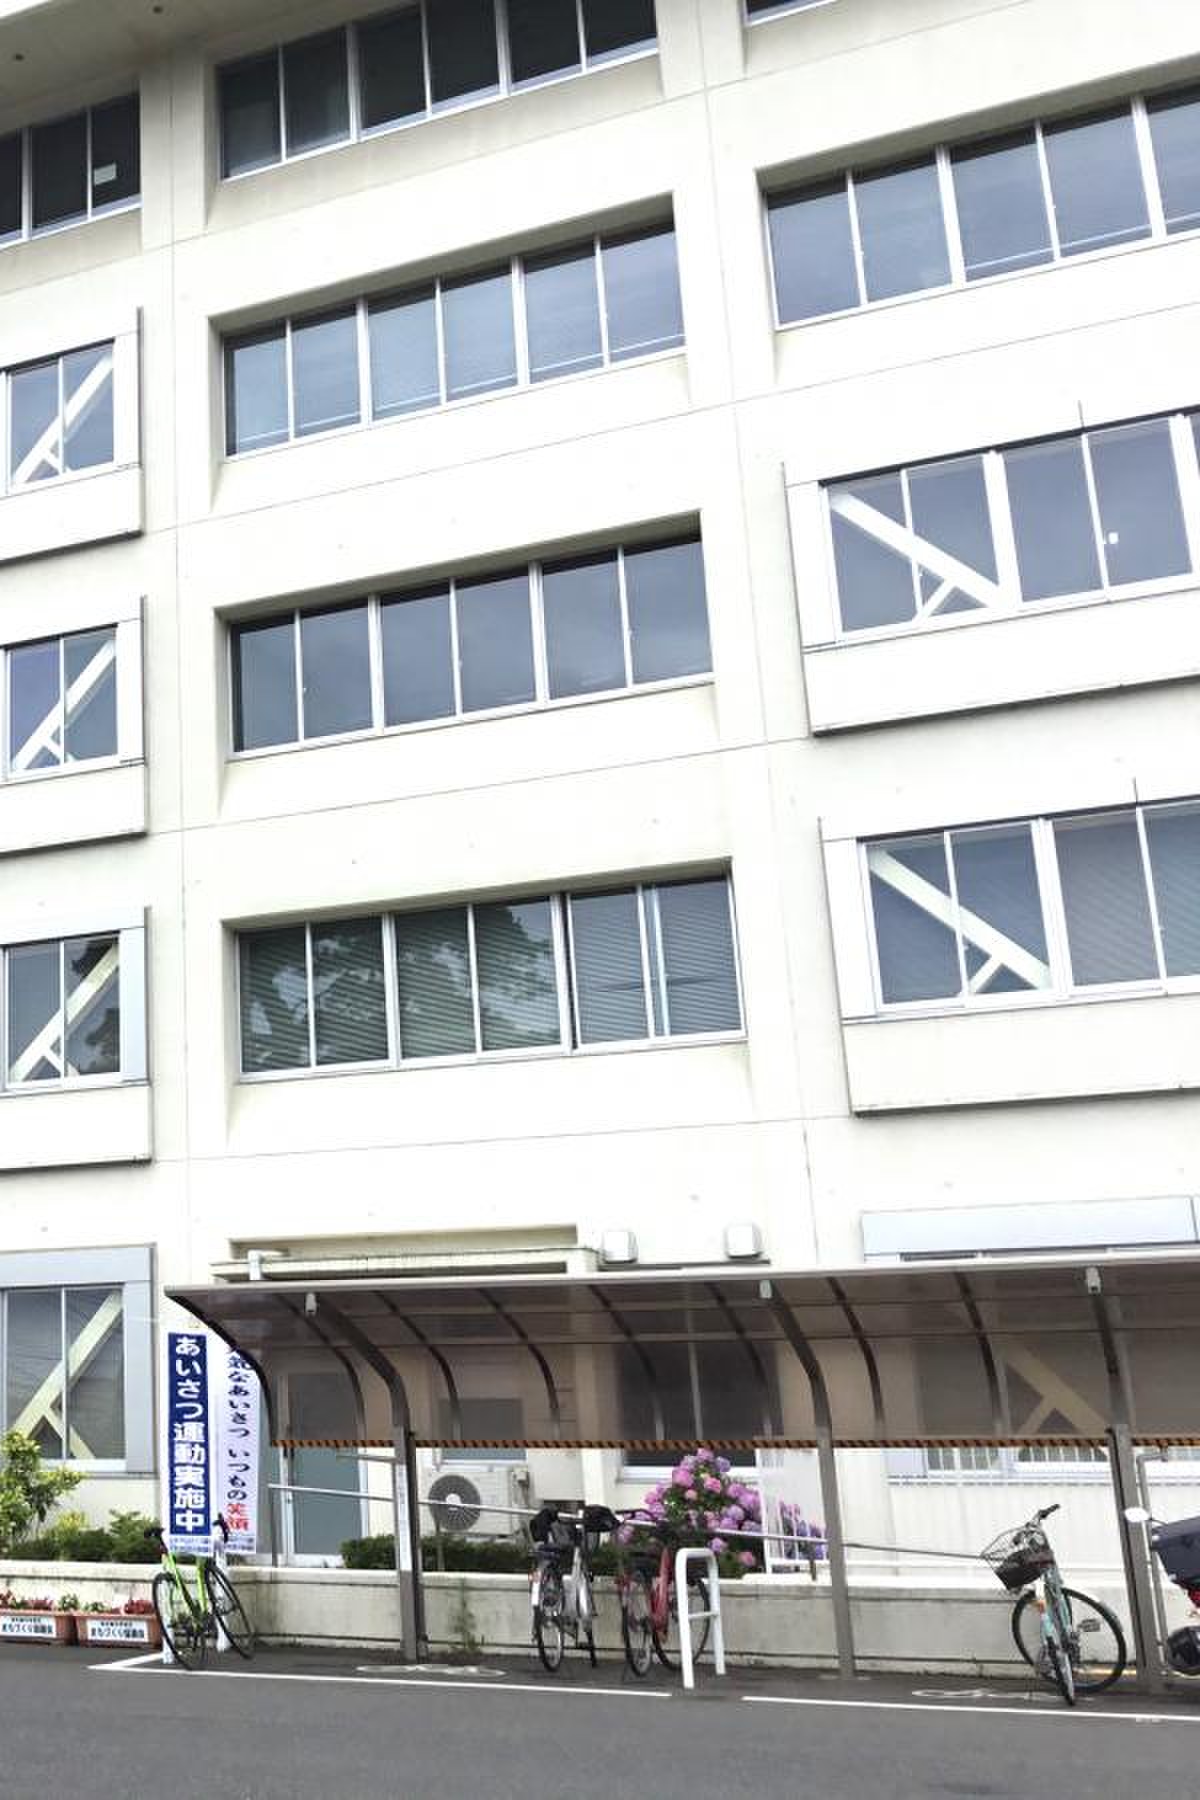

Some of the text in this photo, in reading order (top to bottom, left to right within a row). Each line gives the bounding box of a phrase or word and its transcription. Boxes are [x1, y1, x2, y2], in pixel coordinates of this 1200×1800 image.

[174, 1336, 205, 1532] あいさつ運動実施中
